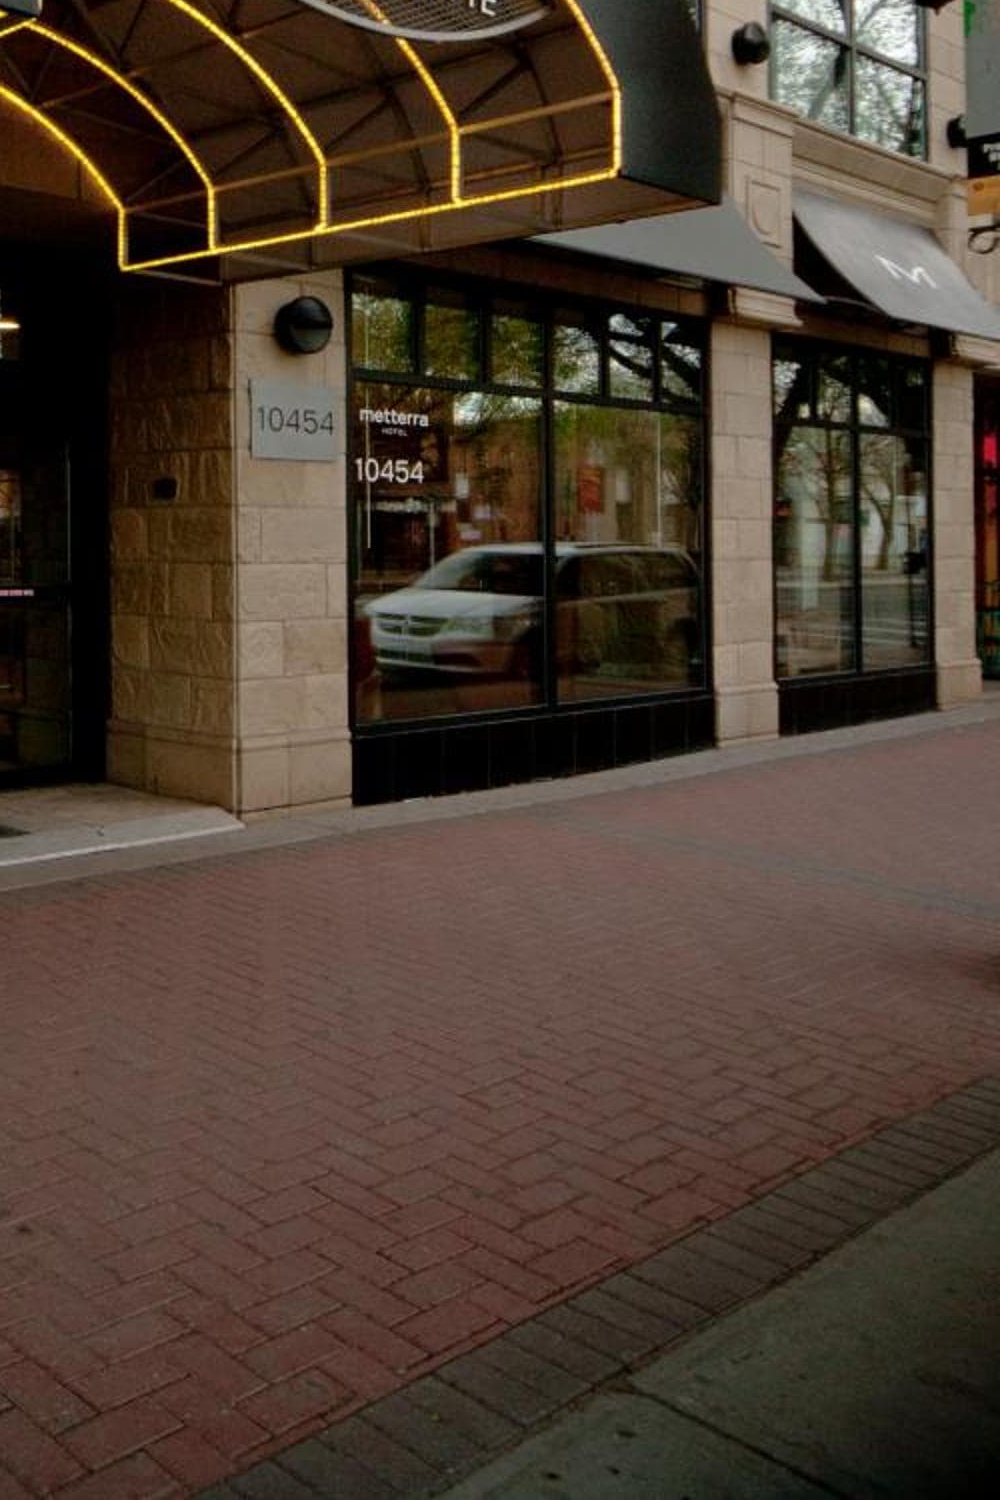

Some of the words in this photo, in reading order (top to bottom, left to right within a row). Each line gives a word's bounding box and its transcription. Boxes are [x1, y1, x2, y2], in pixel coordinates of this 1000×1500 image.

[257, 405, 335, 436] 10454
[359, 407, 430, 427] metterra
[354, 457, 425, 485] 10454
